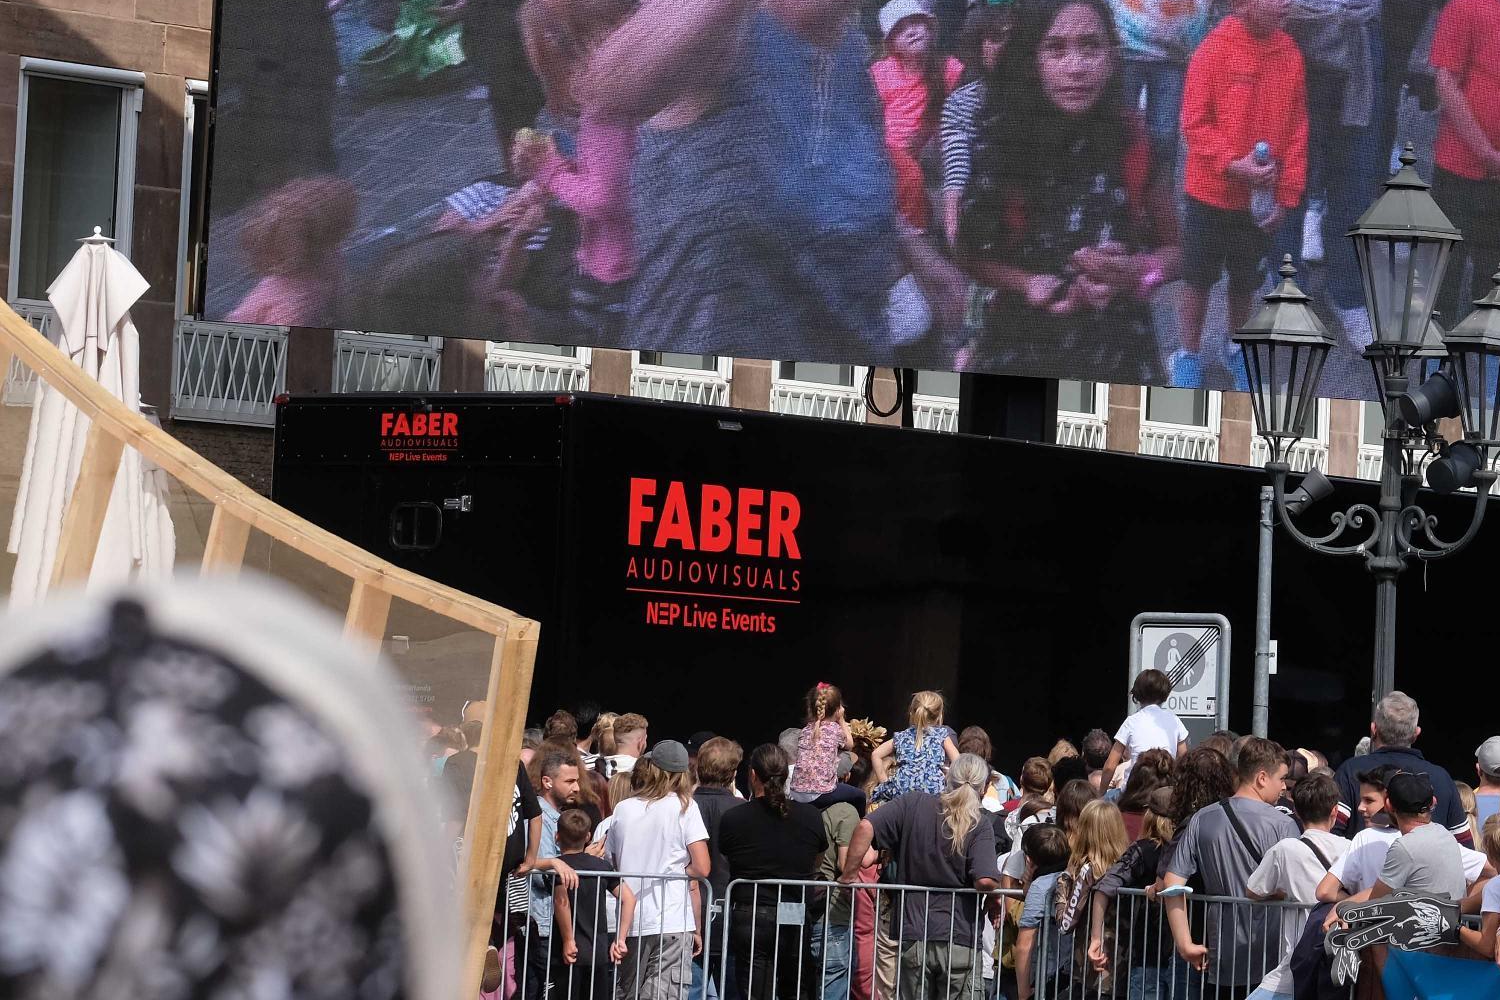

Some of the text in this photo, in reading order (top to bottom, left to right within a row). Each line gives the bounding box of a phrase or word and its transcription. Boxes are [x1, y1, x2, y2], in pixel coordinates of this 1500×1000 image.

[381, 412, 459, 436] FABER
[380, 438, 458, 447] AUDIOVISUALS
[389, 452, 448, 461] NEP Live Events
[627, 477, 802, 560] FABER
[626, 557, 801, 592] AUDIOVISUALS
[646, 601, 776, 633] NEP Live Events
